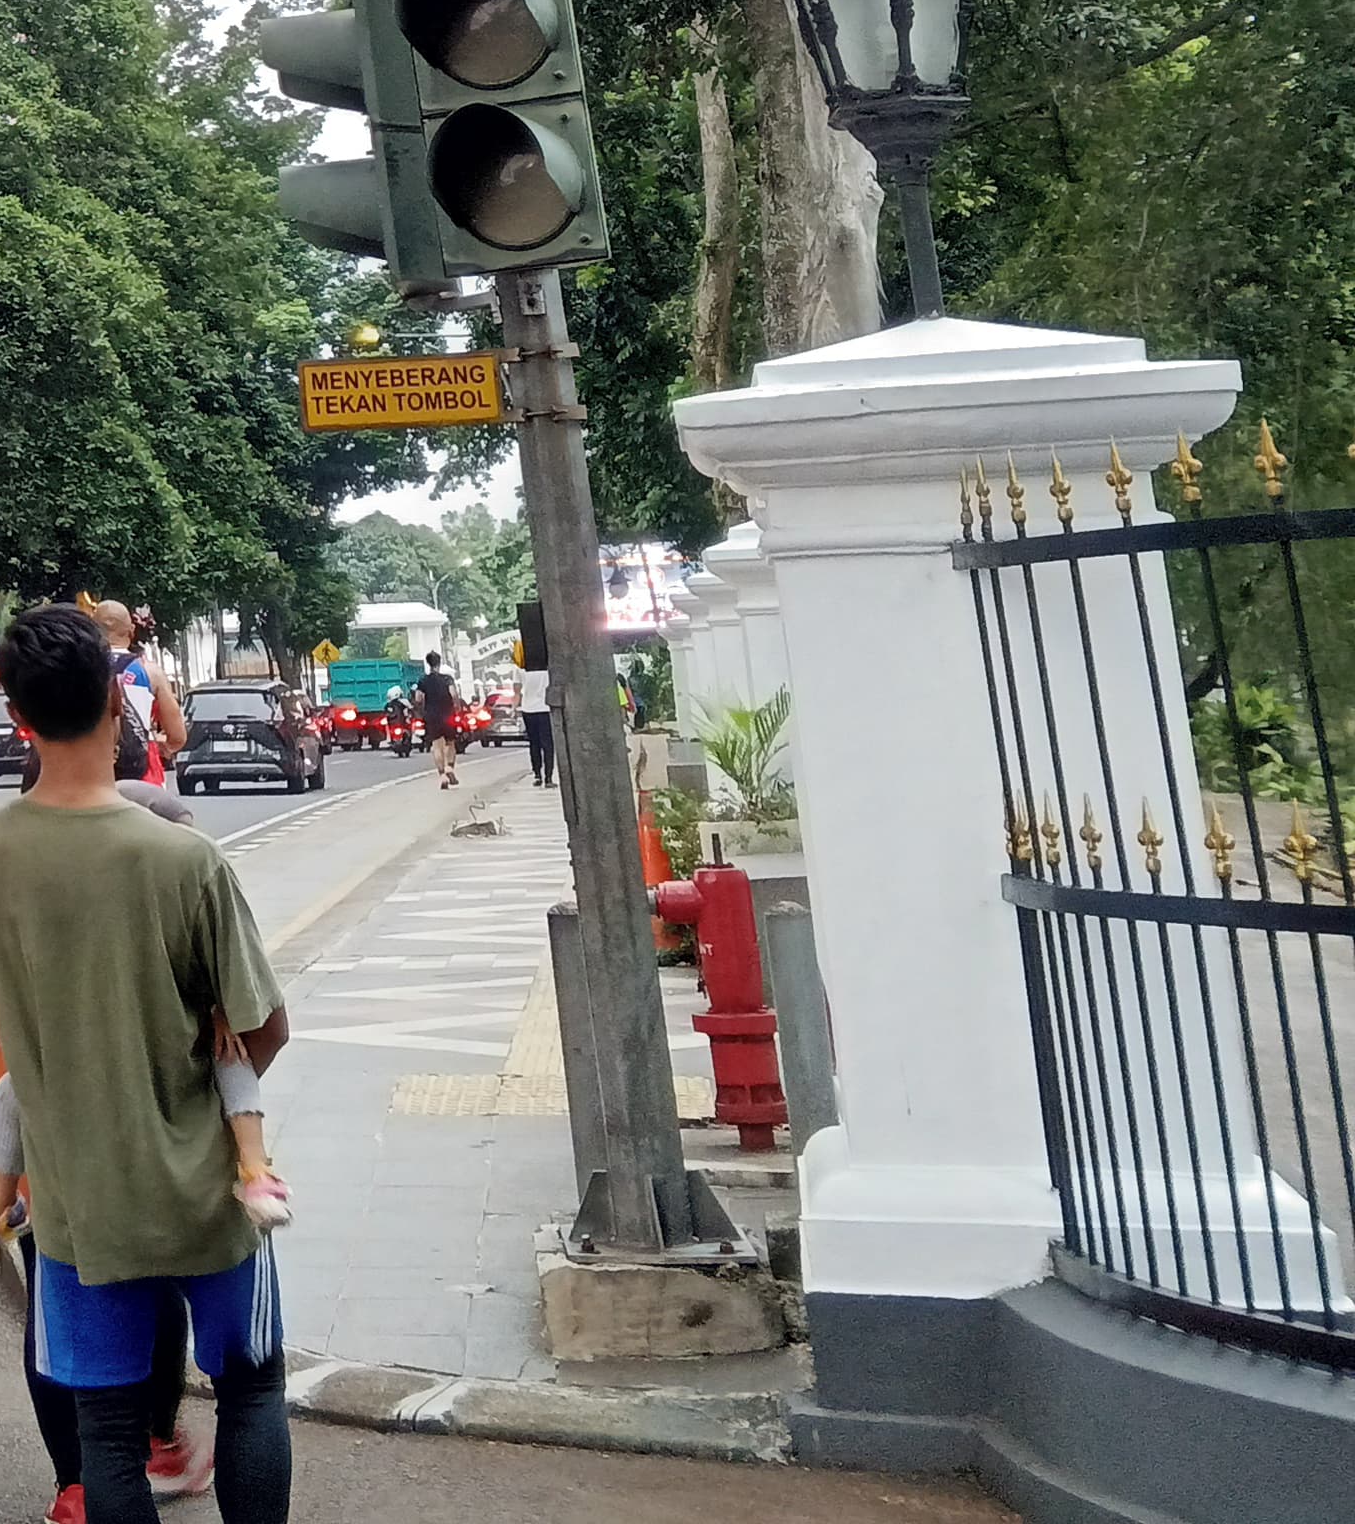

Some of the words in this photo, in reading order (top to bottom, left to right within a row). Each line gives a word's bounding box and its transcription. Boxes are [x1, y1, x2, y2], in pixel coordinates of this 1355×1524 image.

[311, 364, 486, 392] MENYEBERANG
[311, 393, 387, 415] TEKAN
[392, 389, 491, 412] TOMBOL
